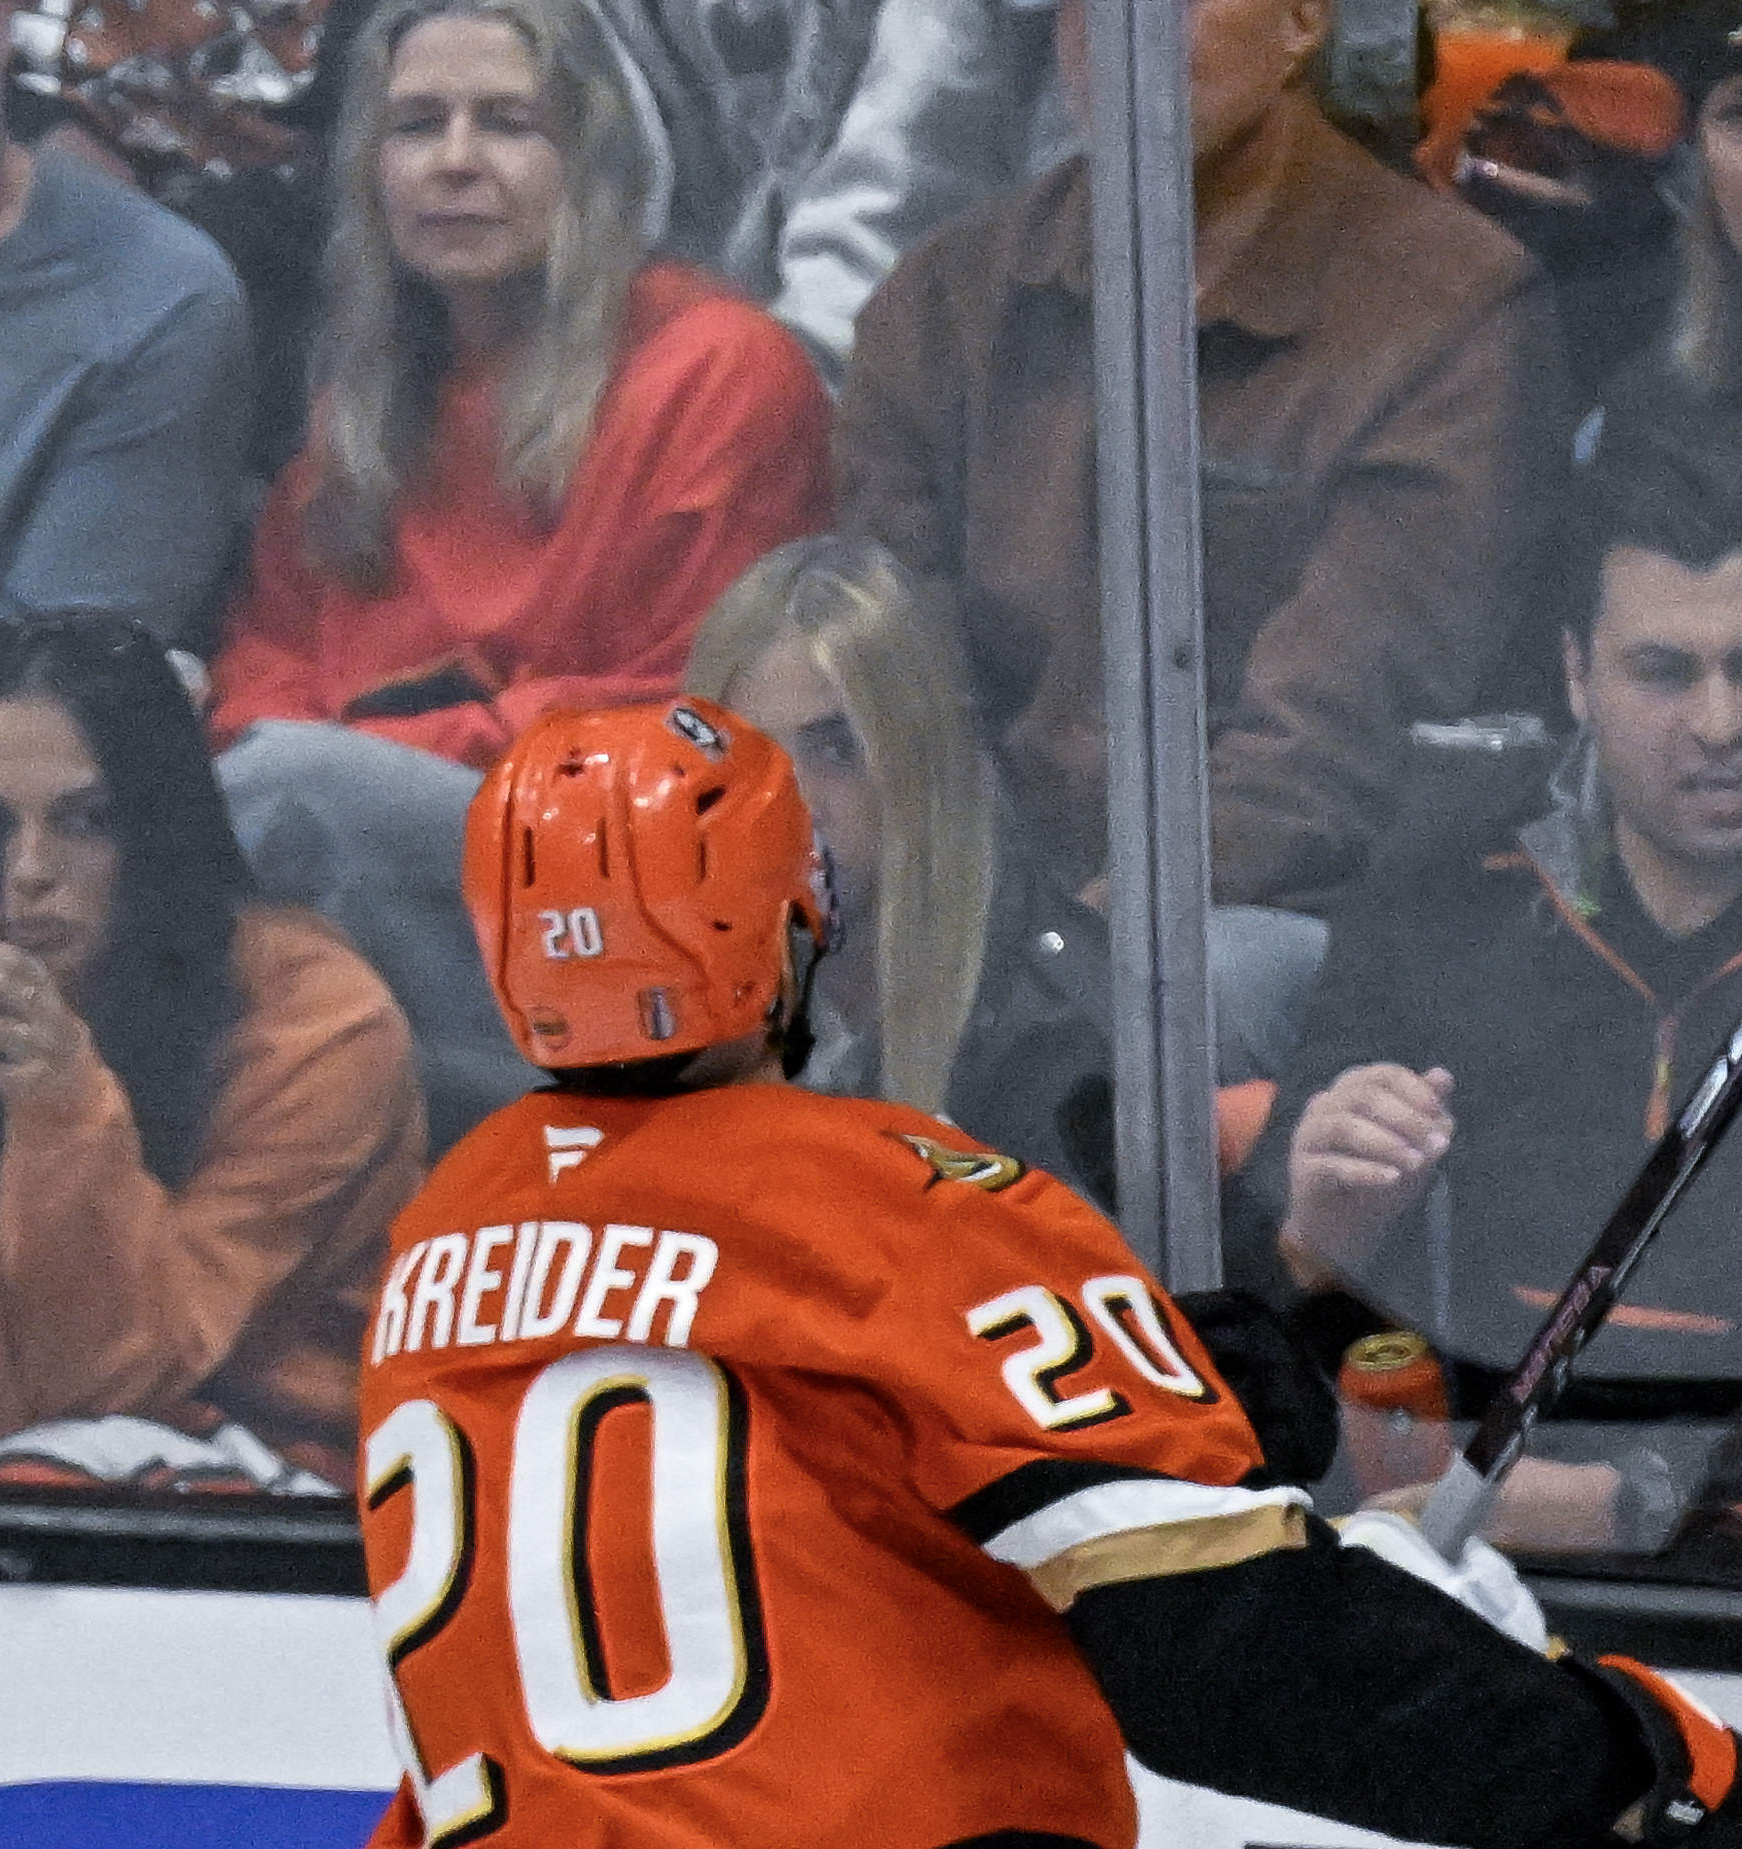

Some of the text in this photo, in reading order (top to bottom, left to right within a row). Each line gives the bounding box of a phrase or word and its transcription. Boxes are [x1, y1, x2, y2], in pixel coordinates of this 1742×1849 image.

[539, 906, 604, 959] 20
[370, 1219, 720, 1366] KREIDER
[967, 1273, 1219, 1433] 20
